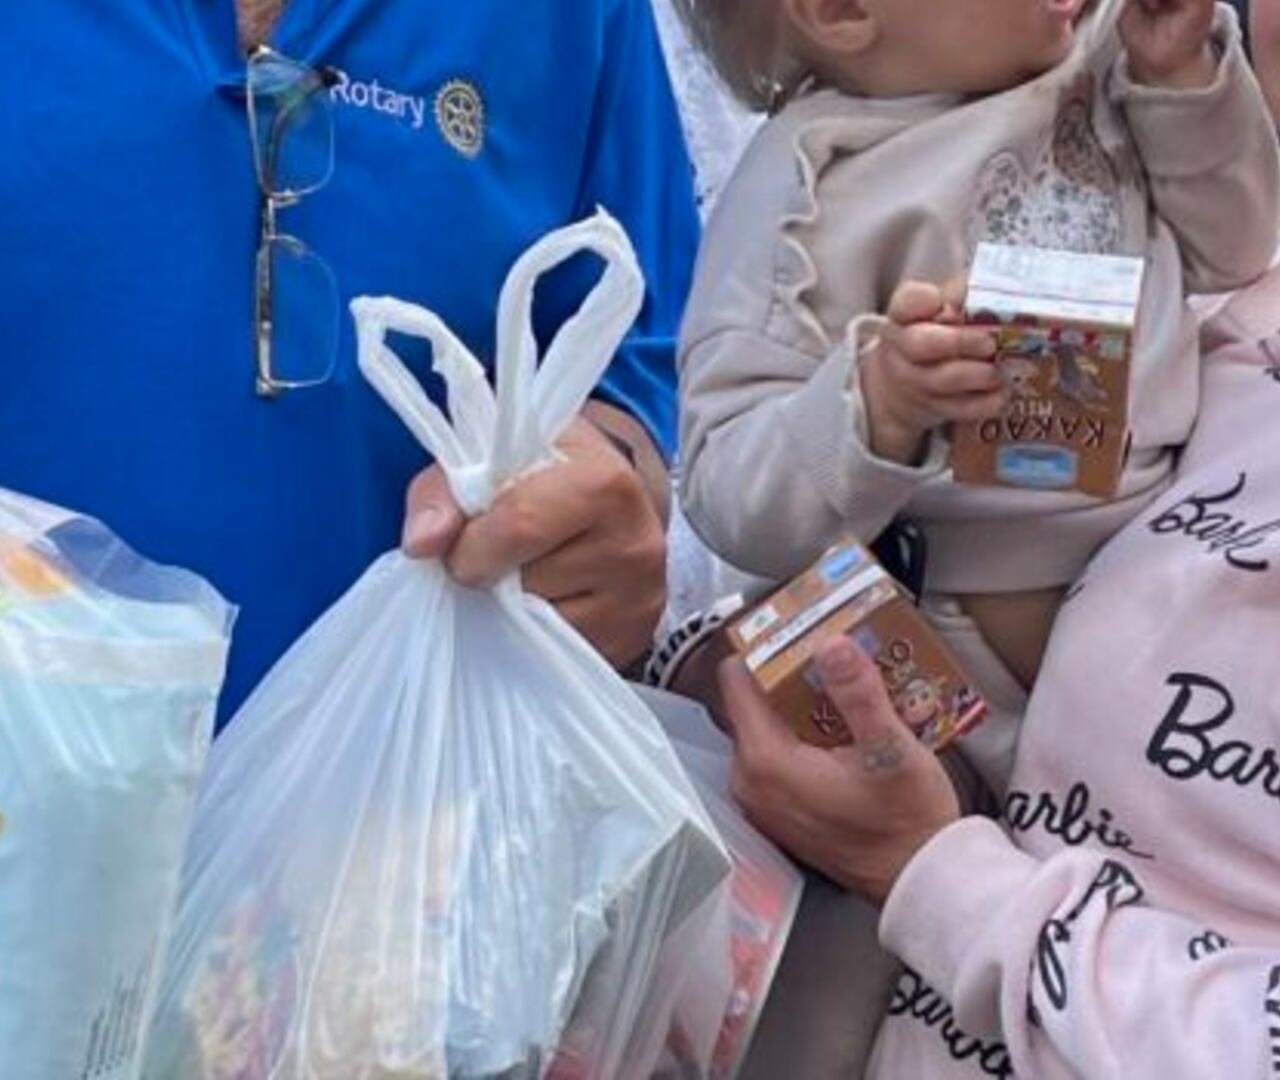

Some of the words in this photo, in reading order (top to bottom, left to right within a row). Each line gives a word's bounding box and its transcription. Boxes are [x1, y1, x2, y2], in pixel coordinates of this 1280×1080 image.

[329, 68, 425, 128] Rotary
[978, 416, 1106, 450] KAKAO
[1004, 782, 1154, 860] arbie
